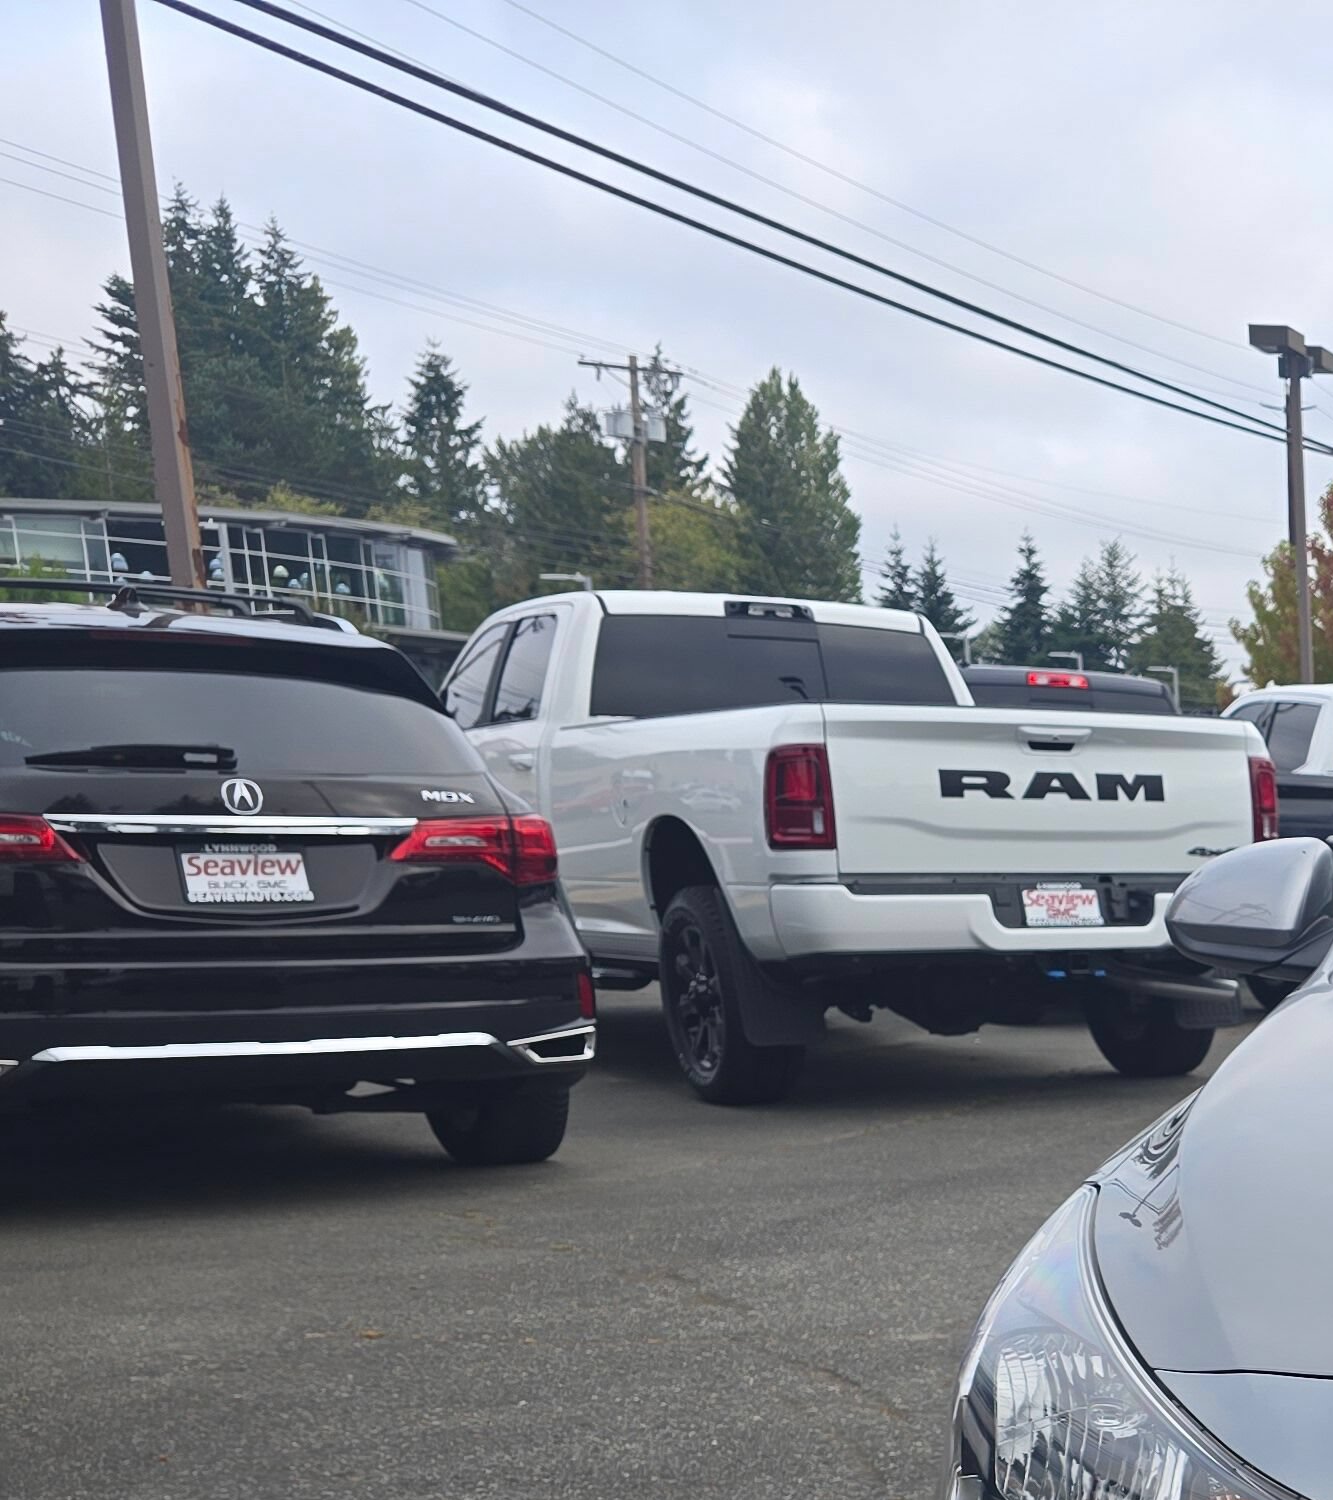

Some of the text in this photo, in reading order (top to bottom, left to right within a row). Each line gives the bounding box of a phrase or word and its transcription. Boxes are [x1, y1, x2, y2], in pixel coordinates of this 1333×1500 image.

[938, 768, 1166, 802] RAM
[421, 789, 475, 804] MDX
[204, 843, 278, 853] LYNNWOOD
[186, 854, 304, 877] Seaview
[207, 880, 247, 889] BUICK
